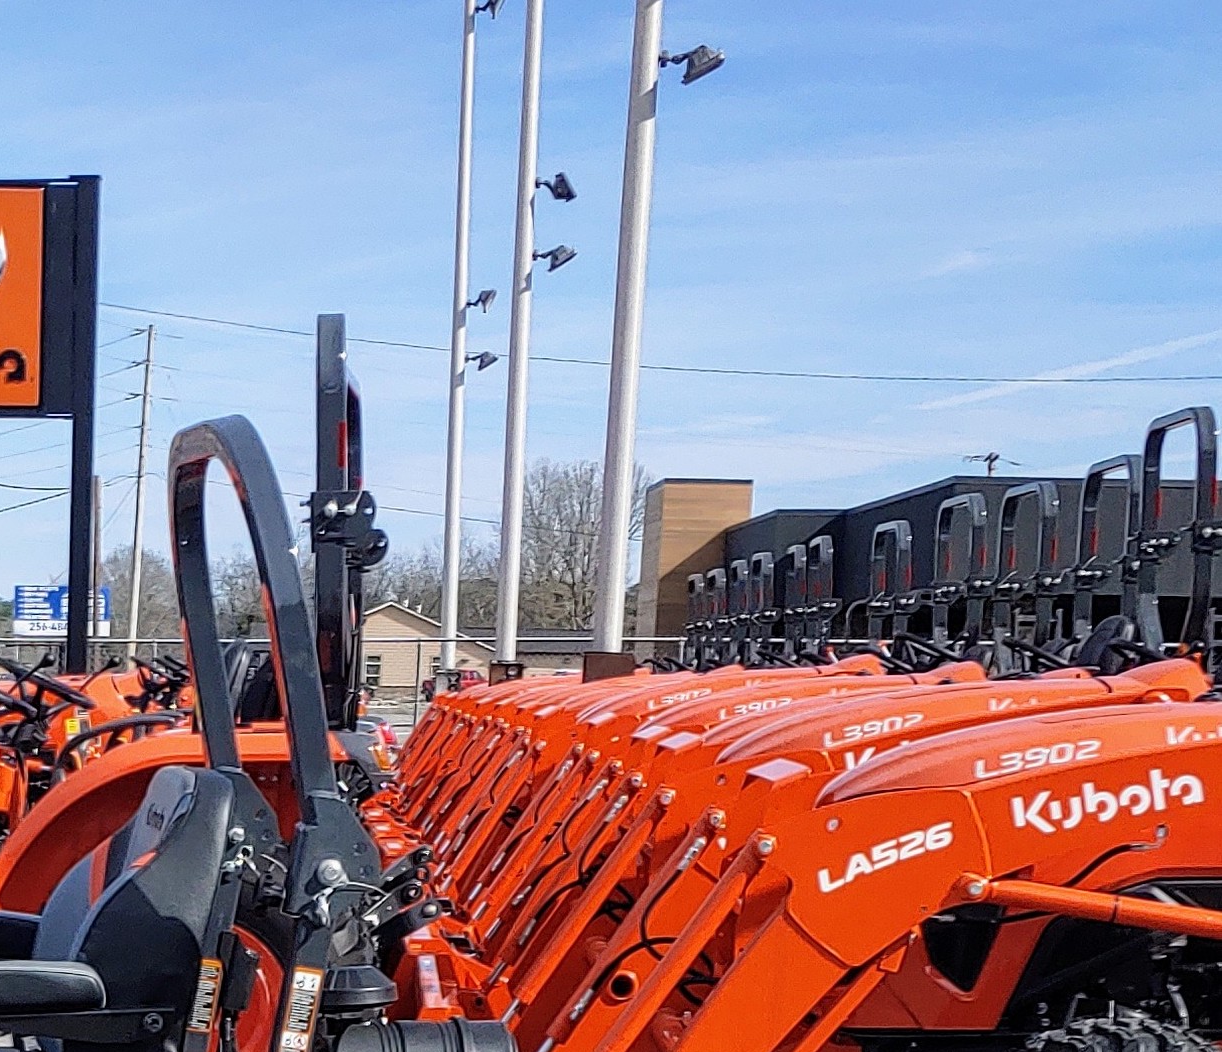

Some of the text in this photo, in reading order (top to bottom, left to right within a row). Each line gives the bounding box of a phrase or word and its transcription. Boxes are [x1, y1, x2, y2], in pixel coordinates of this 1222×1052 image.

[823, 714, 924, 748] L3902
[974, 739, 1101, 779] L3902
[1011, 768, 1205, 834] Kubota
[817, 822, 954, 894] LA526
